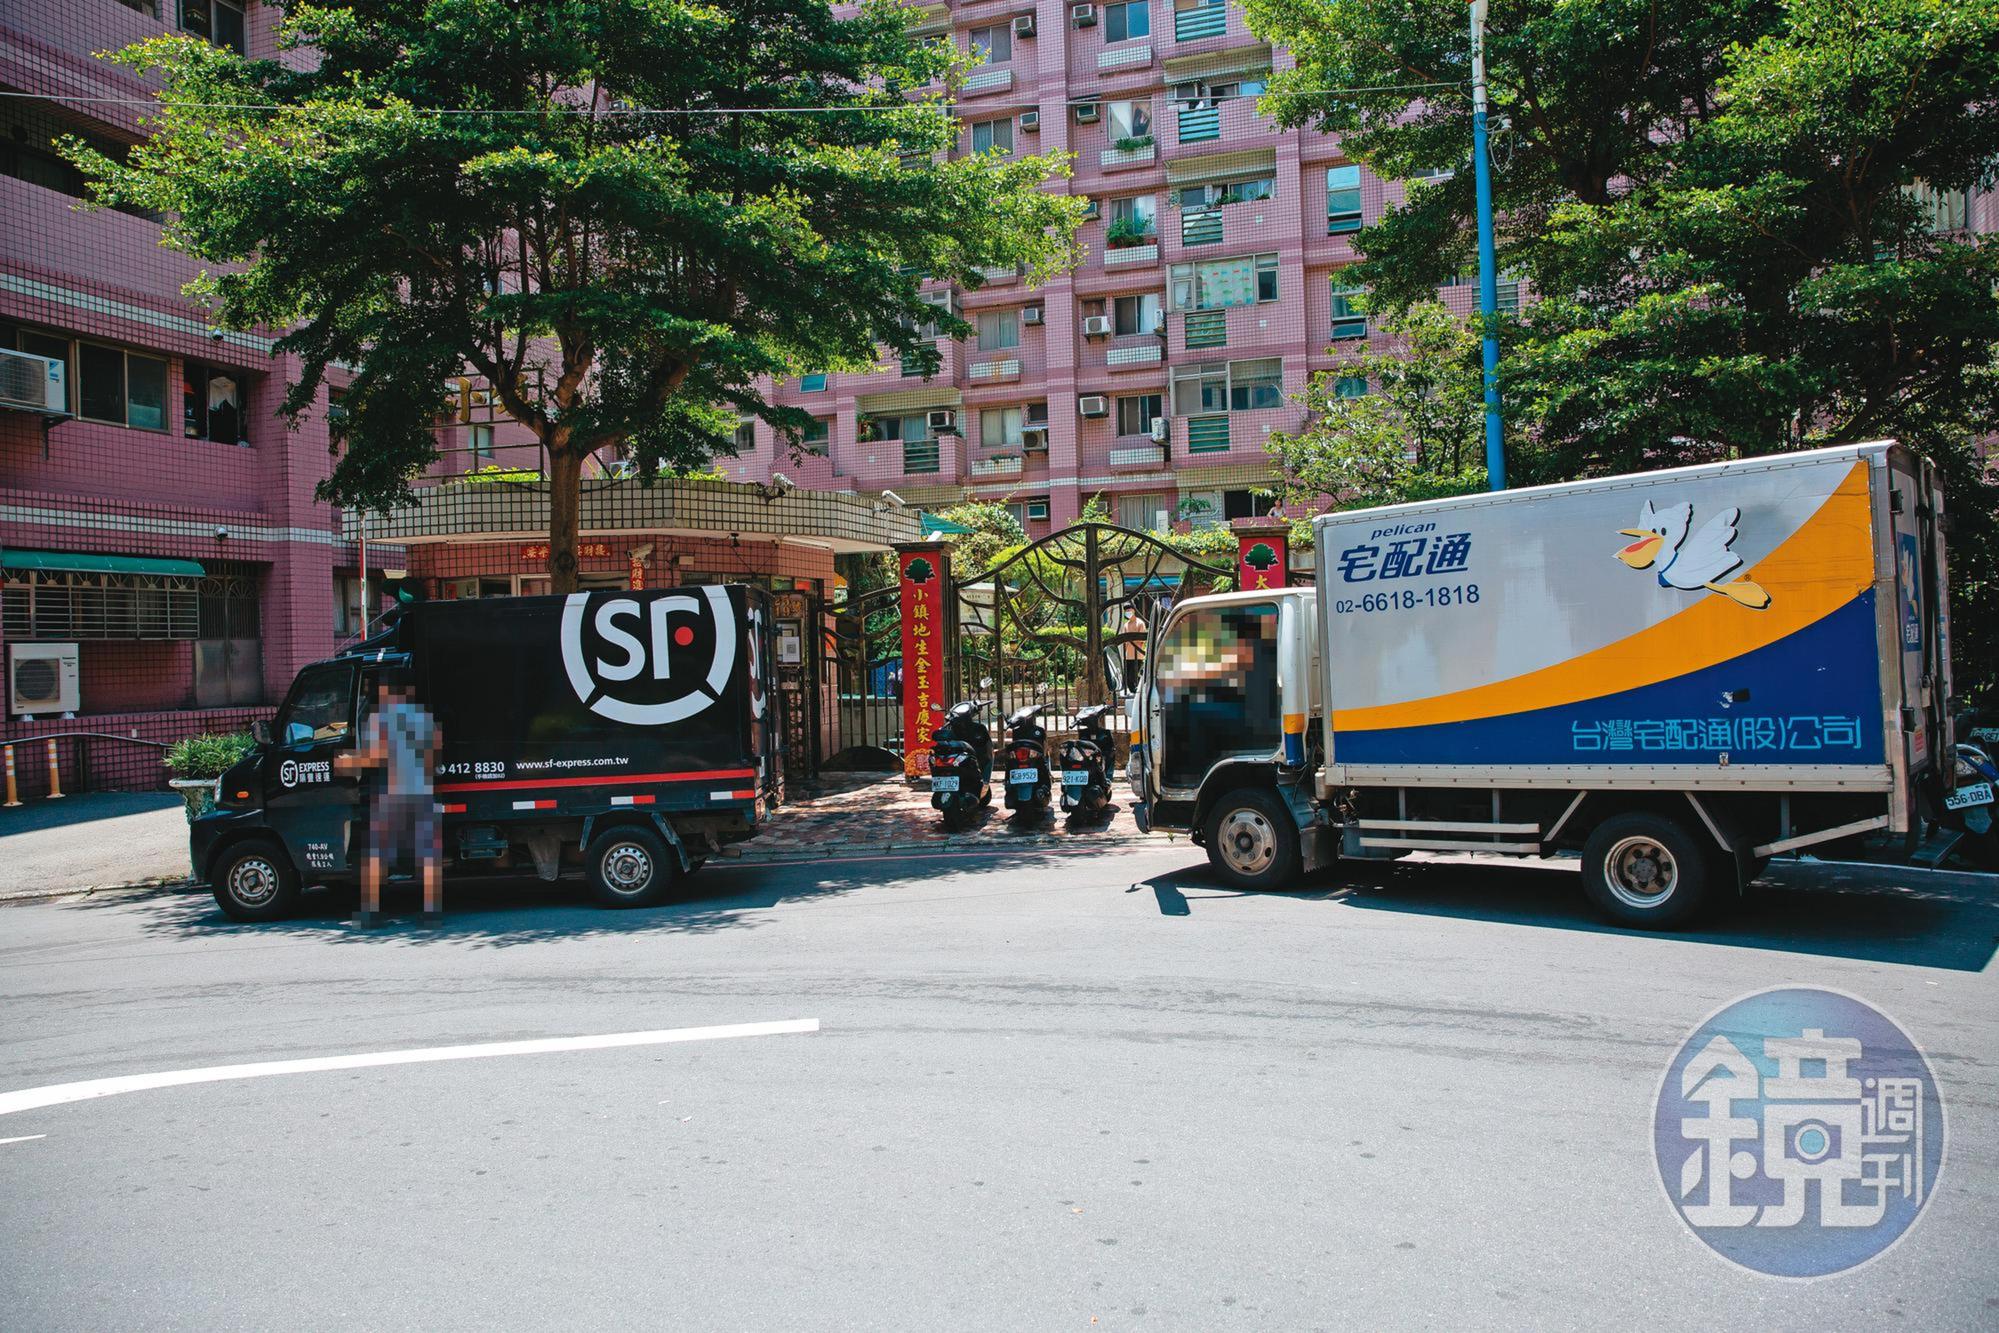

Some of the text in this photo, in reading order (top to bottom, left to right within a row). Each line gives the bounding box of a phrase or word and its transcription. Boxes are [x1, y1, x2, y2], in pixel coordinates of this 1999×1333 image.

[1370, 522, 1437, 540] pelican
[1336, 532, 1472, 583] 宅配通
[1336, 584, 1480, 613] 02-6618-1818
[1571, 716, 1862, 750] 台灣宅配通(股)公司
[299, 761, 330, 772] EXPRESS
[448, 761, 505, 774] 412 8830
[516, 756, 629, 770] www.sf-express.com.tw
